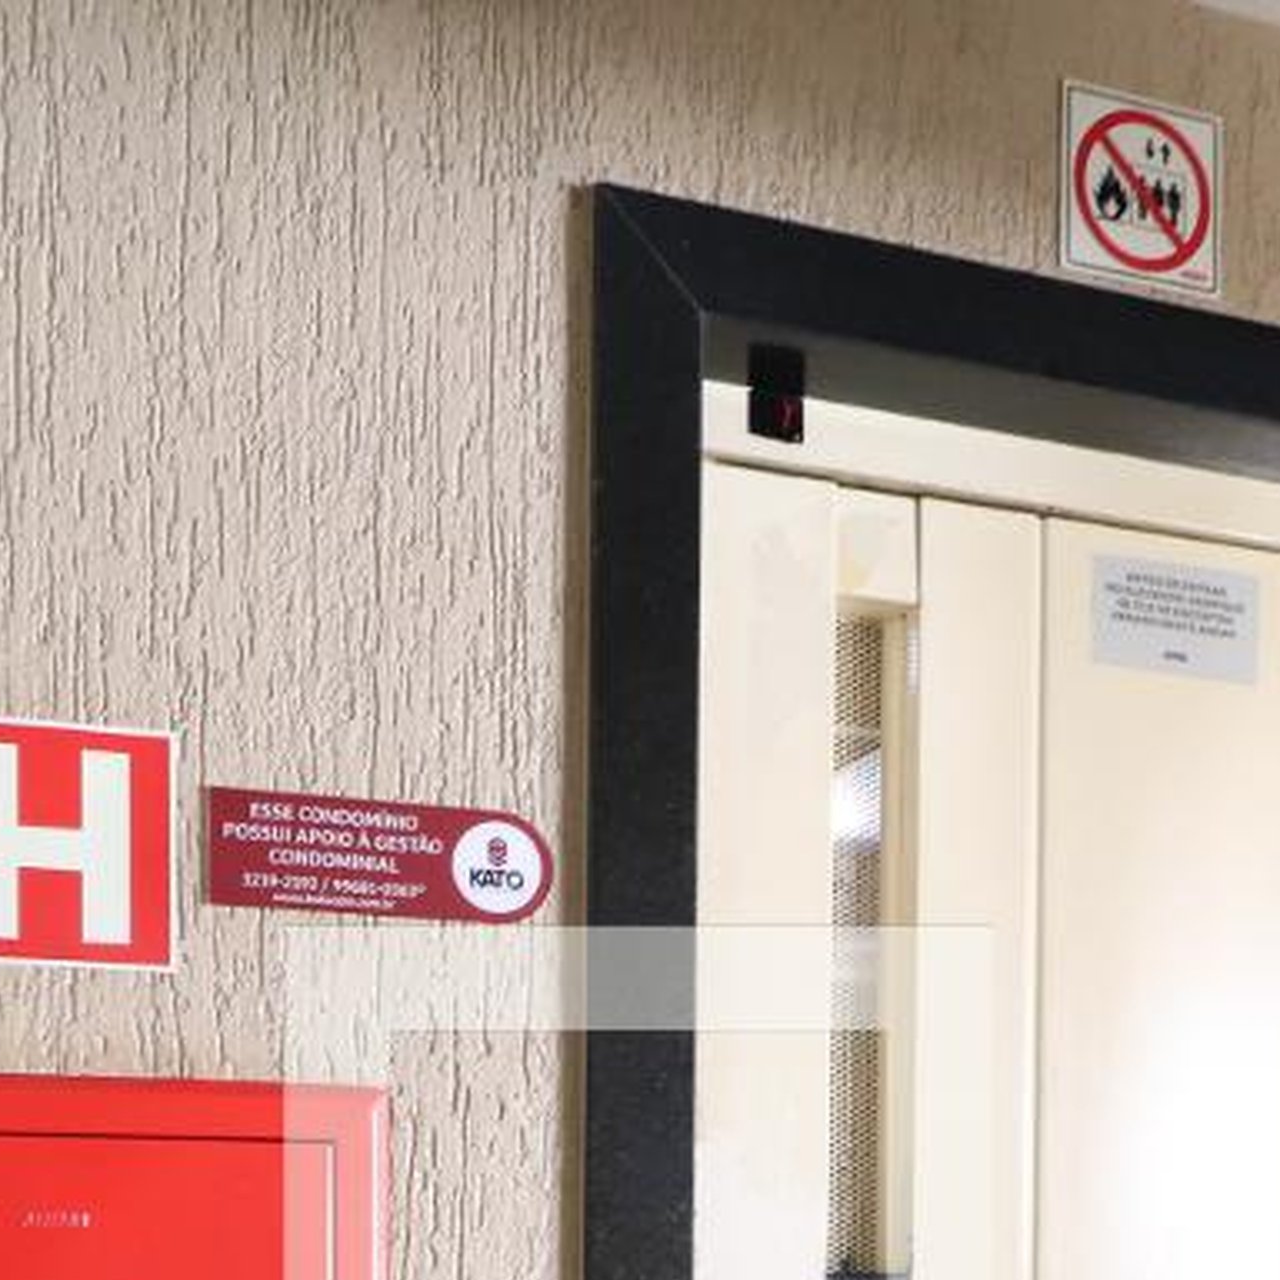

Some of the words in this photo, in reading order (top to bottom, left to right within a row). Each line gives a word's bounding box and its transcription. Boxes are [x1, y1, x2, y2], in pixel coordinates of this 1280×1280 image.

[249, 803, 294, 821] ESSE
[298, 805, 419, 831] CONDOMÍNIO
[222, 821, 291, 842] POSSUI
[295, 827, 354, 848] APOIO
[374, 832, 444, 854] GESTÃO
[268, 848, 400, 874] CONDOMINIAL
[469, 868, 524, 891] KATO
